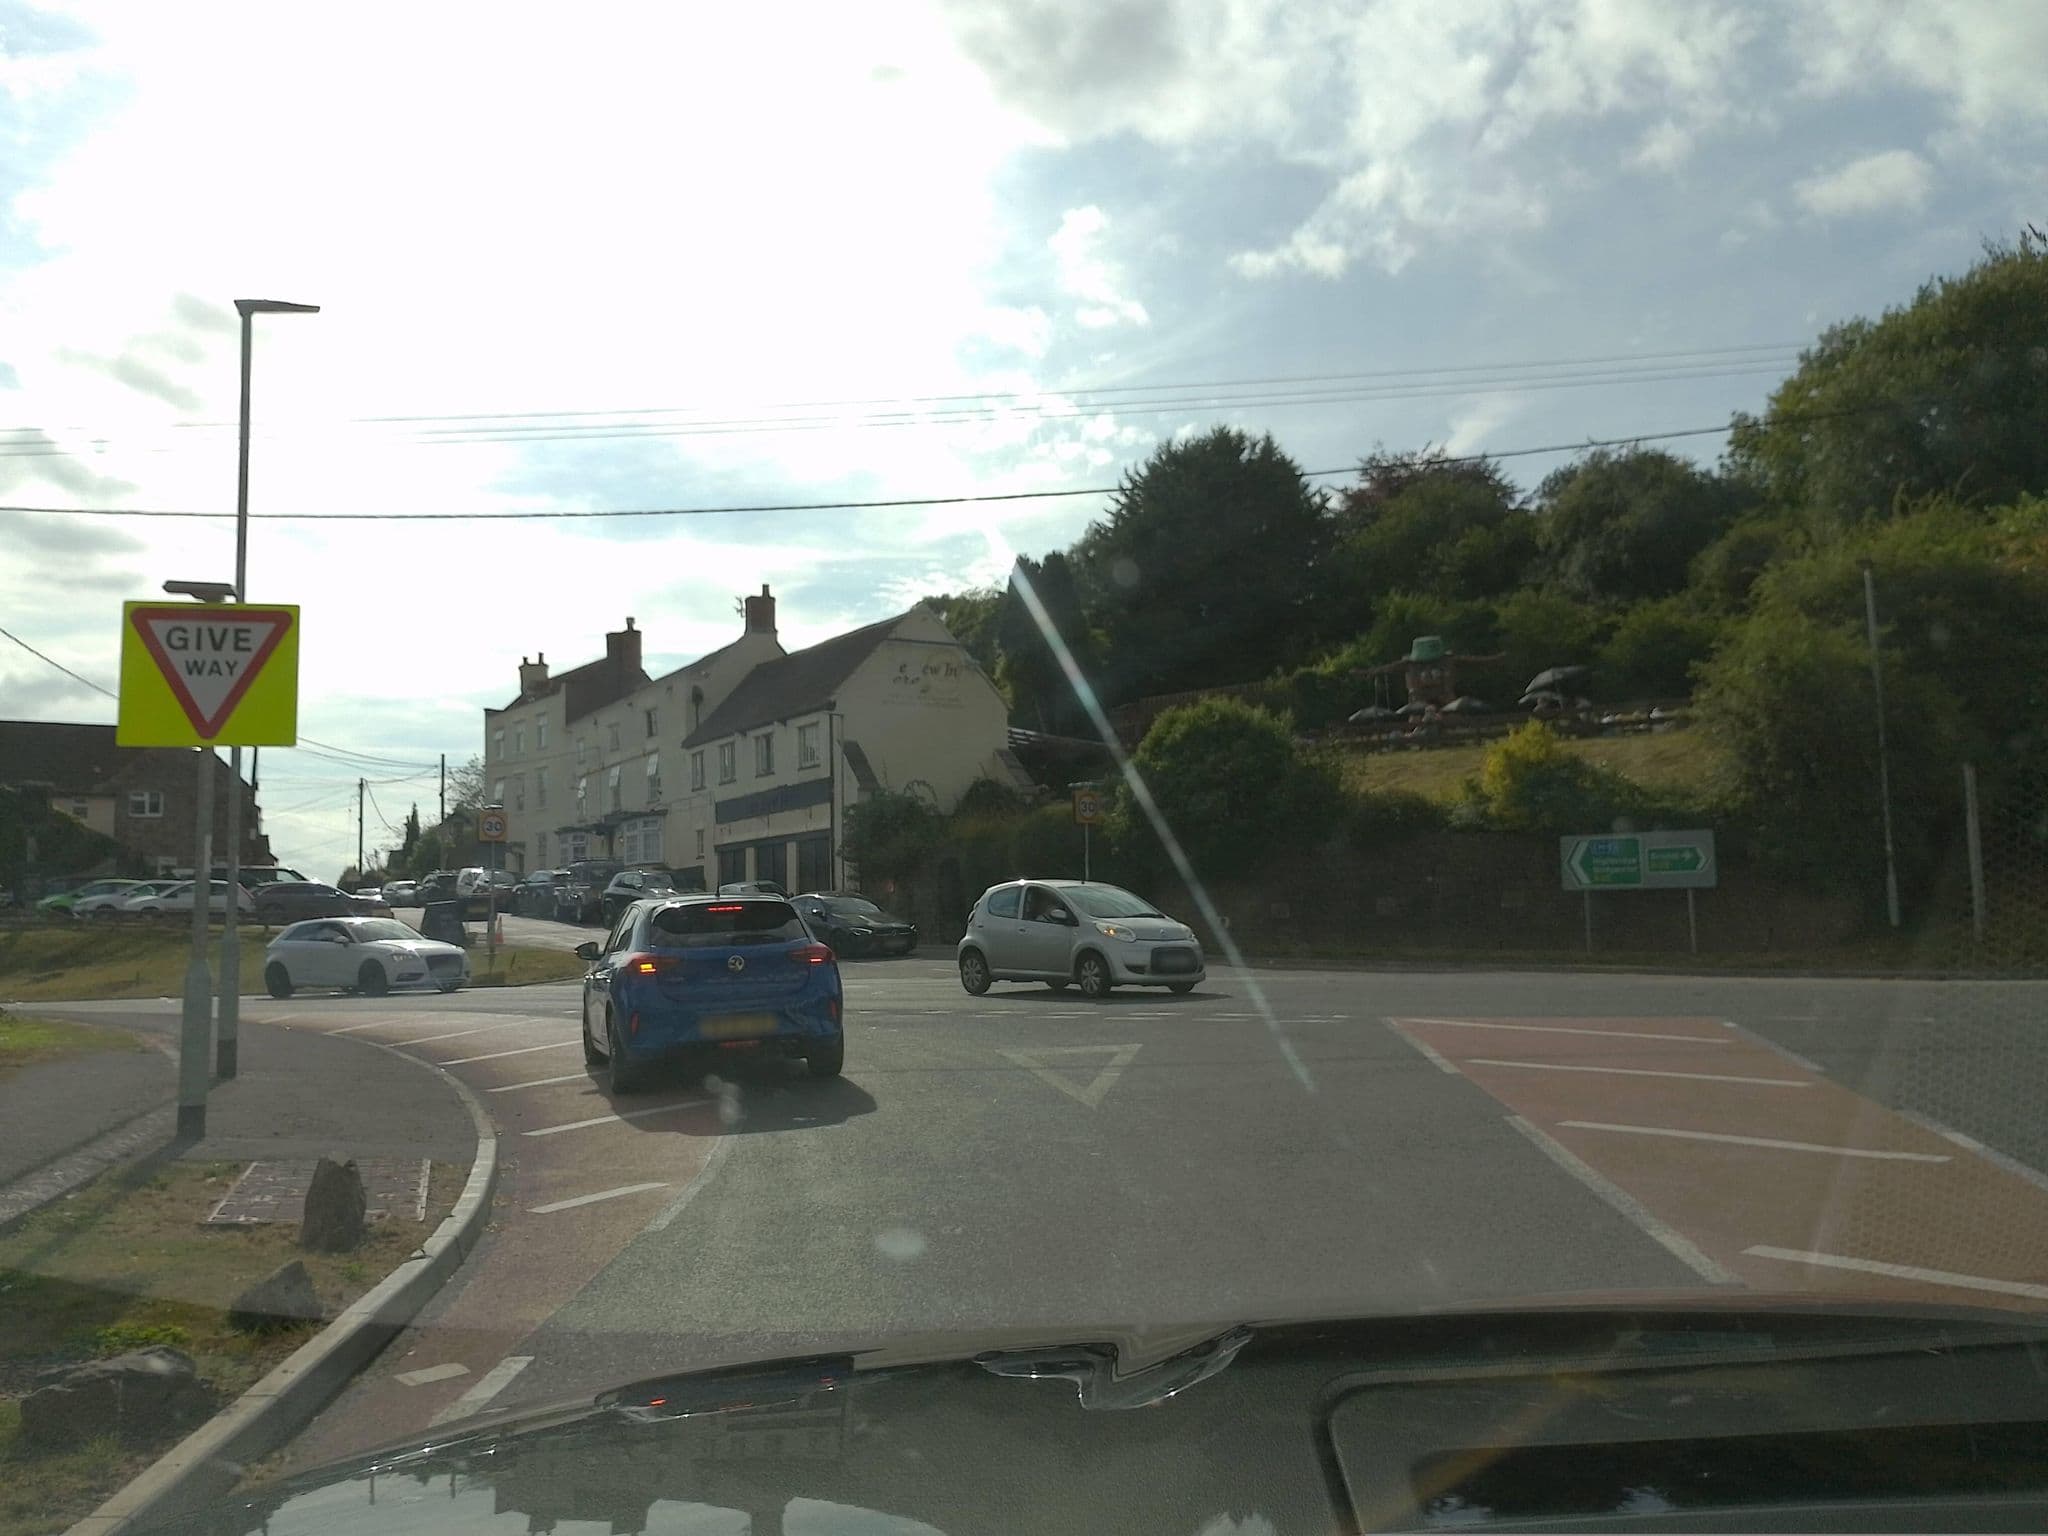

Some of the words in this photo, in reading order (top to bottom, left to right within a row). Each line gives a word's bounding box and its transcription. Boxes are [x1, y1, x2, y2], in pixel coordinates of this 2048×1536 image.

[166, 627, 253, 652] GIVE
[185, 660, 239, 677] WAY
[1080, 800, 1096, 812] 30
[486, 821, 503, 832] 30
